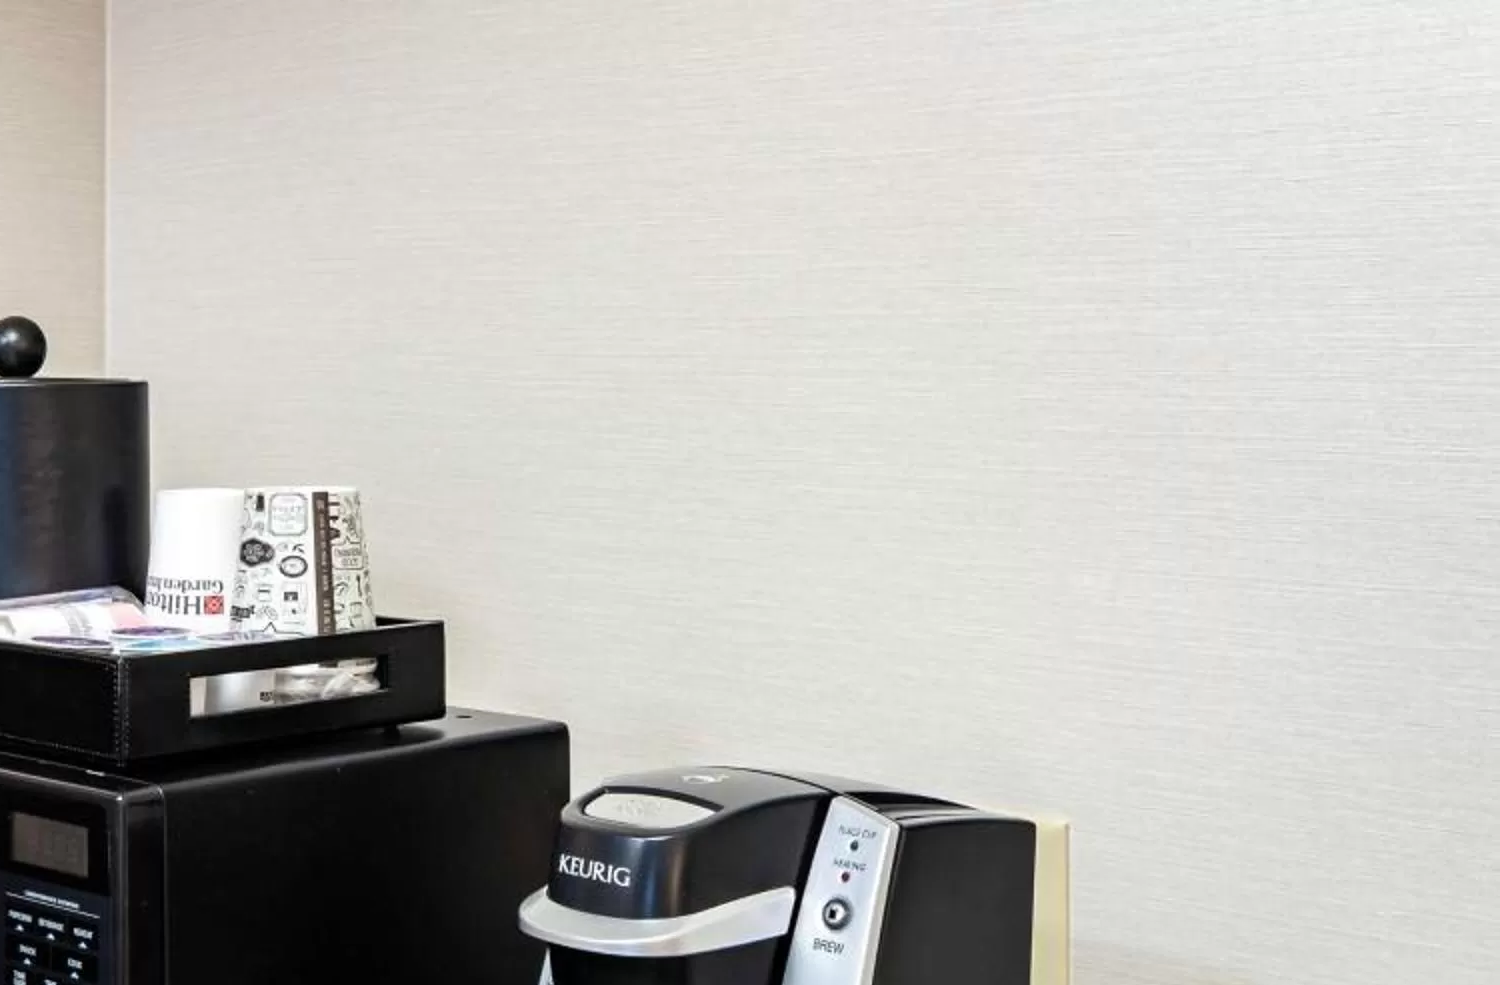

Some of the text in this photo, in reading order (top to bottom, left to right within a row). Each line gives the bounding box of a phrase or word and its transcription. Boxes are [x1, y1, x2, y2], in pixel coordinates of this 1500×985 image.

[163, 577, 223, 594] Garden
[558, 853, 631, 887] KEURIG
[812, 938, 844, 955] BREW
